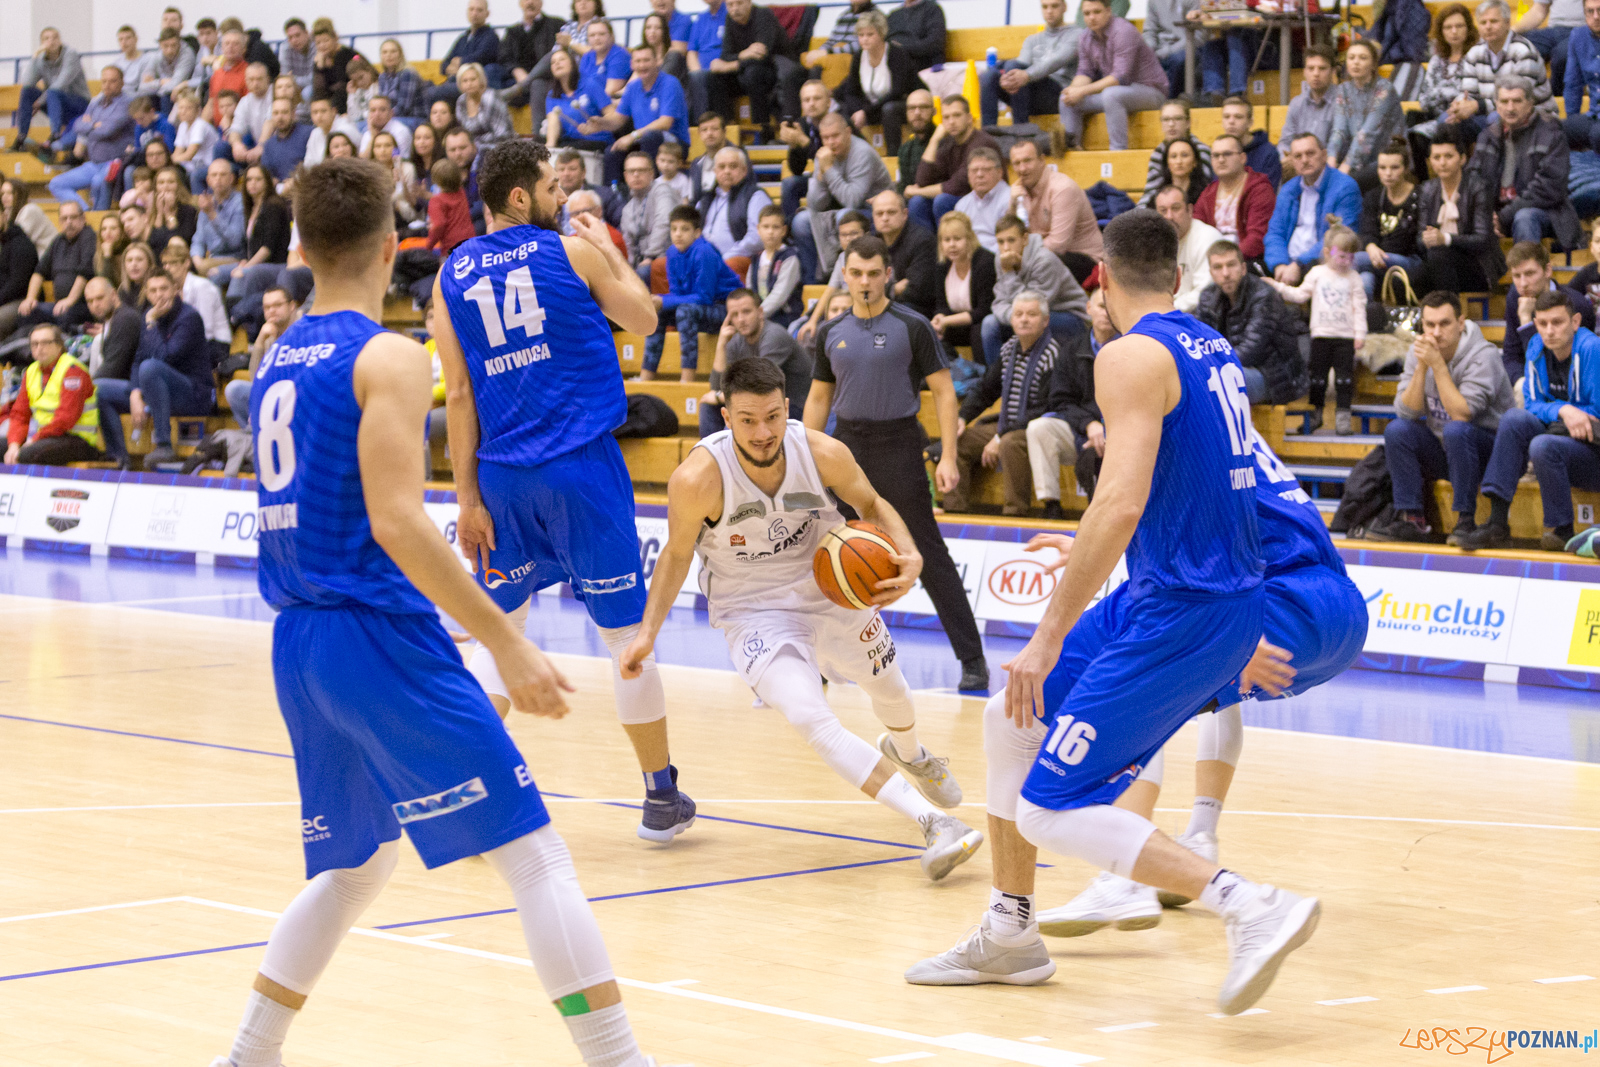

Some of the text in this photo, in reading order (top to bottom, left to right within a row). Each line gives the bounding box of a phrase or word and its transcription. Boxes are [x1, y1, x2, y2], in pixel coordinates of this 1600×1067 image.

[481, 240, 538, 268] Energa
[463, 265, 547, 348] 14
[274, 342, 336, 368] Energa
[484, 342, 552, 377] KOTWICA
[1207, 362, 1253, 456] 16
[257, 379, 297, 493] 8
[1581, 505, 1590, 521] 6
[999, 569, 1044, 597] KIA
[1378, 592, 1505, 629] funclub
[864, 616, 882, 640] KIA
[1376, 618, 1502, 641] biuro podróży
[1045, 713, 1097, 766] 16
